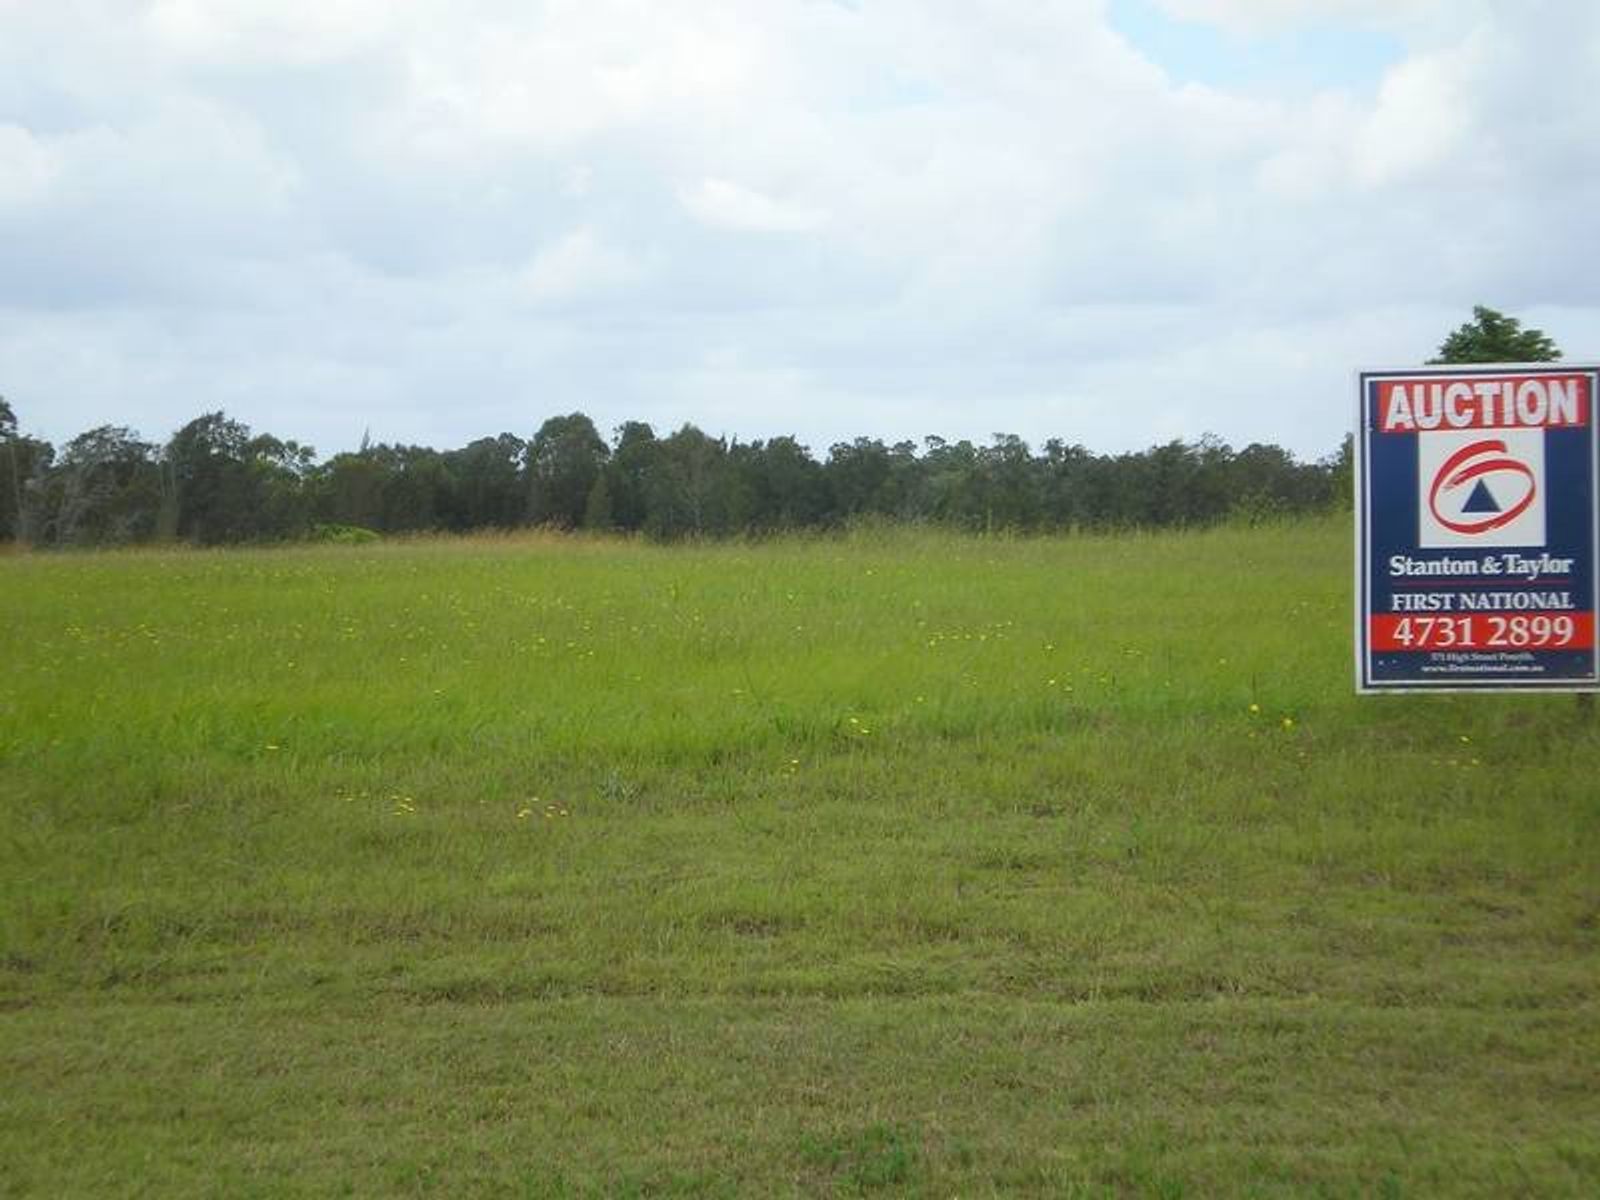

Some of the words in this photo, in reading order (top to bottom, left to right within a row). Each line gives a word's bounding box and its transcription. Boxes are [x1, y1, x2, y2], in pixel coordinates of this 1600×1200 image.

[1384, 379, 1578, 430] AUCTION
[1389, 555, 1478, 576] Stanton
[1481, 556, 1501, 575] &
[1502, 553, 1574, 581] Taylor
[1391, 593, 1455, 611] FIRST
[1459, 592, 1575, 609] NATIONAL
[1393, 617, 1475, 647] 4731
[1487, 616, 1574, 646] 2899
